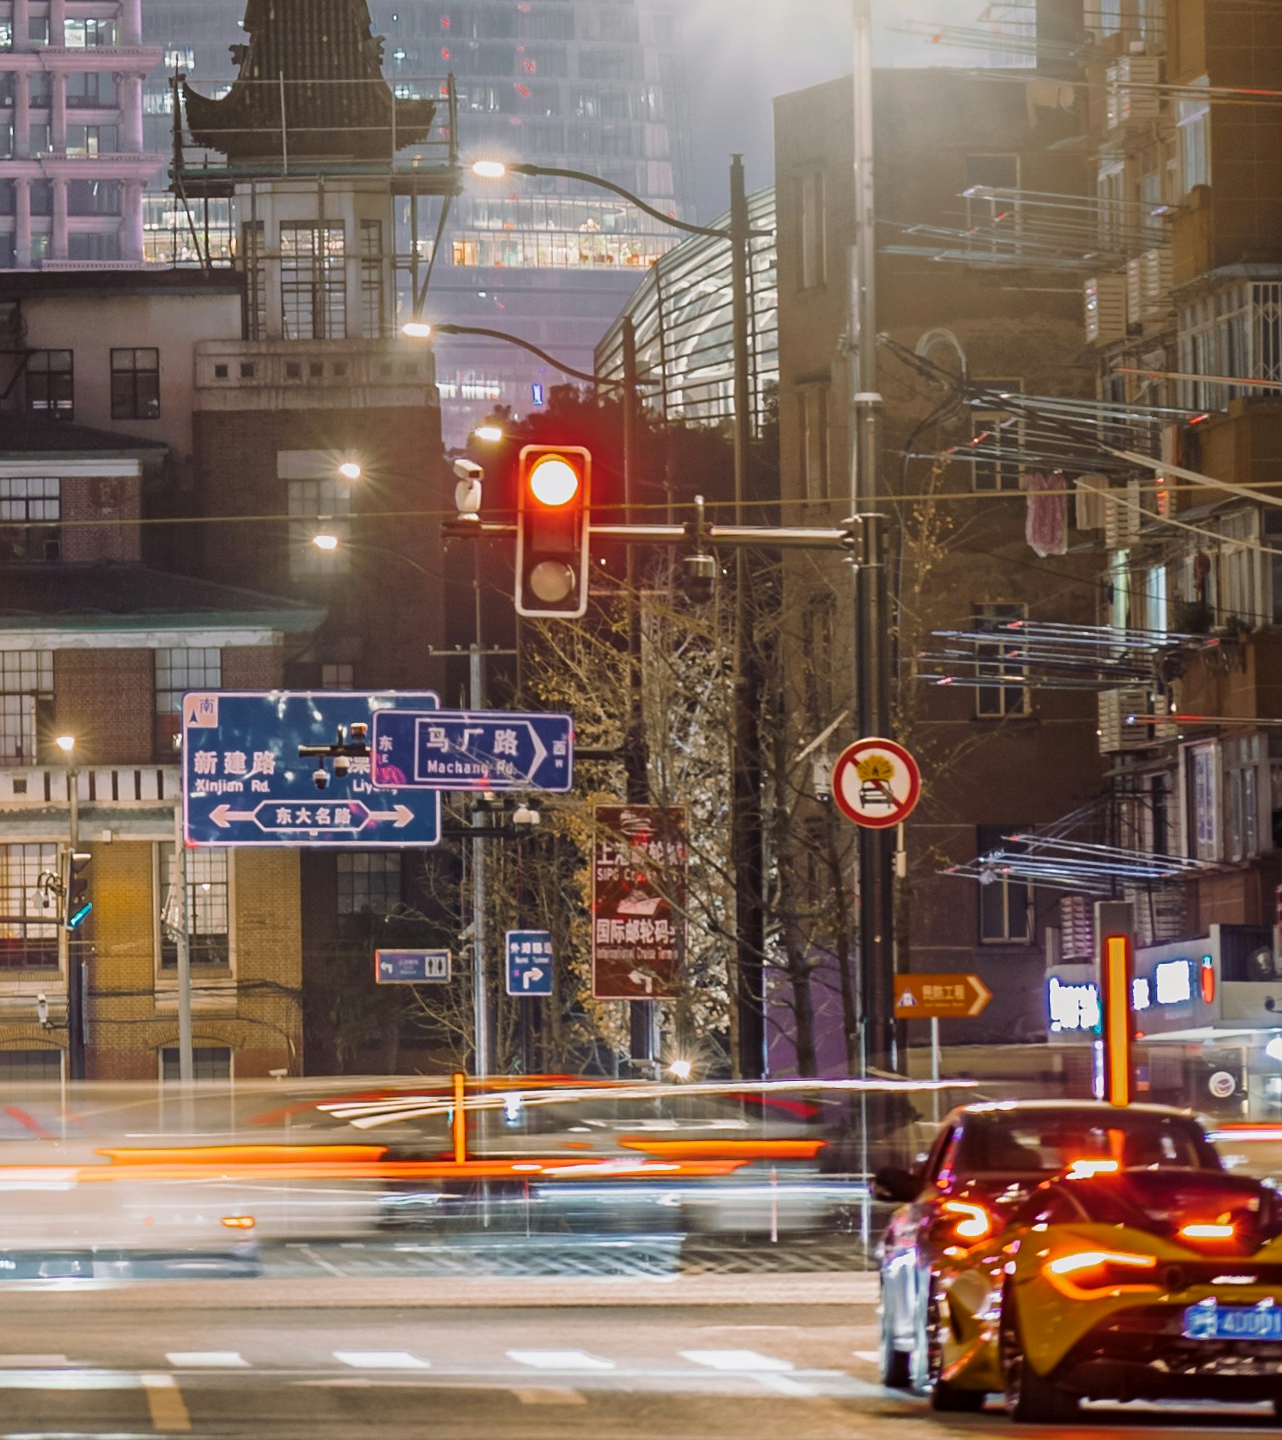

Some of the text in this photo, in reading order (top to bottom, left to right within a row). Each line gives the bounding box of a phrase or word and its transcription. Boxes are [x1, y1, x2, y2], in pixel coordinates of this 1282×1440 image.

[199, 699, 215, 714] 南
[379, 736, 393, 751] 东
[427, 727, 519, 756] 马厂路
[552, 740, 566, 756] 西
[194, 750, 276, 775] 新建路
[427, 760, 488, 777] Machang
[196, 779, 271, 796] Xinjian Rd.
[352, 778, 398, 796] Liy
[276, 807, 351, 826] 东大名路
